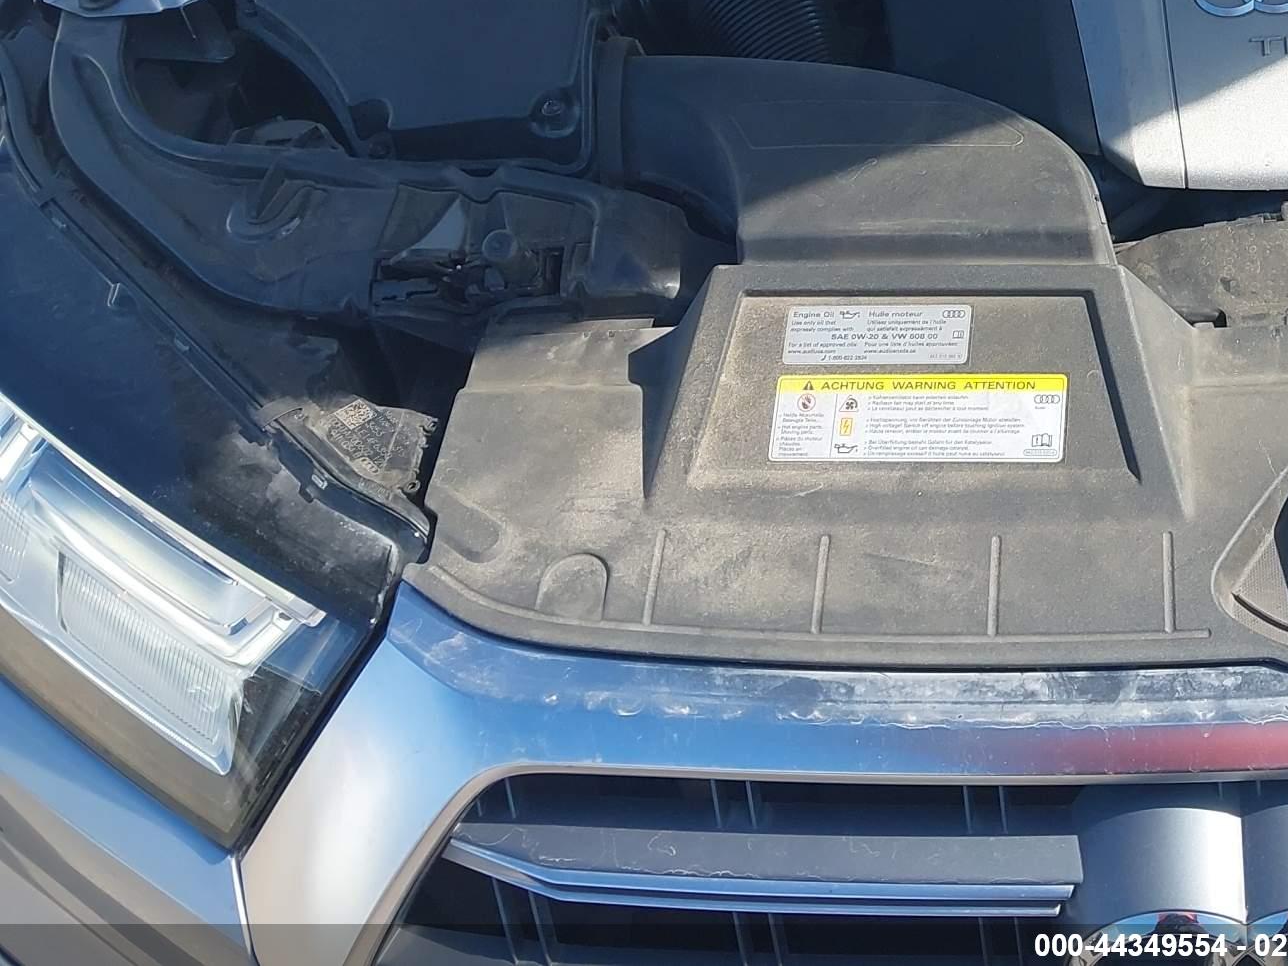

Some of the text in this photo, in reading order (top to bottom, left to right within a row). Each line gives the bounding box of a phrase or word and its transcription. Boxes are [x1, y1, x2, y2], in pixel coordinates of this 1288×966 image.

[793, 310, 834, 319] Engine Oil
[868, 310, 923, 318] Huile moteur
[821, 381, 1036, 390] ACHTUNG WARNING ATTENTION
